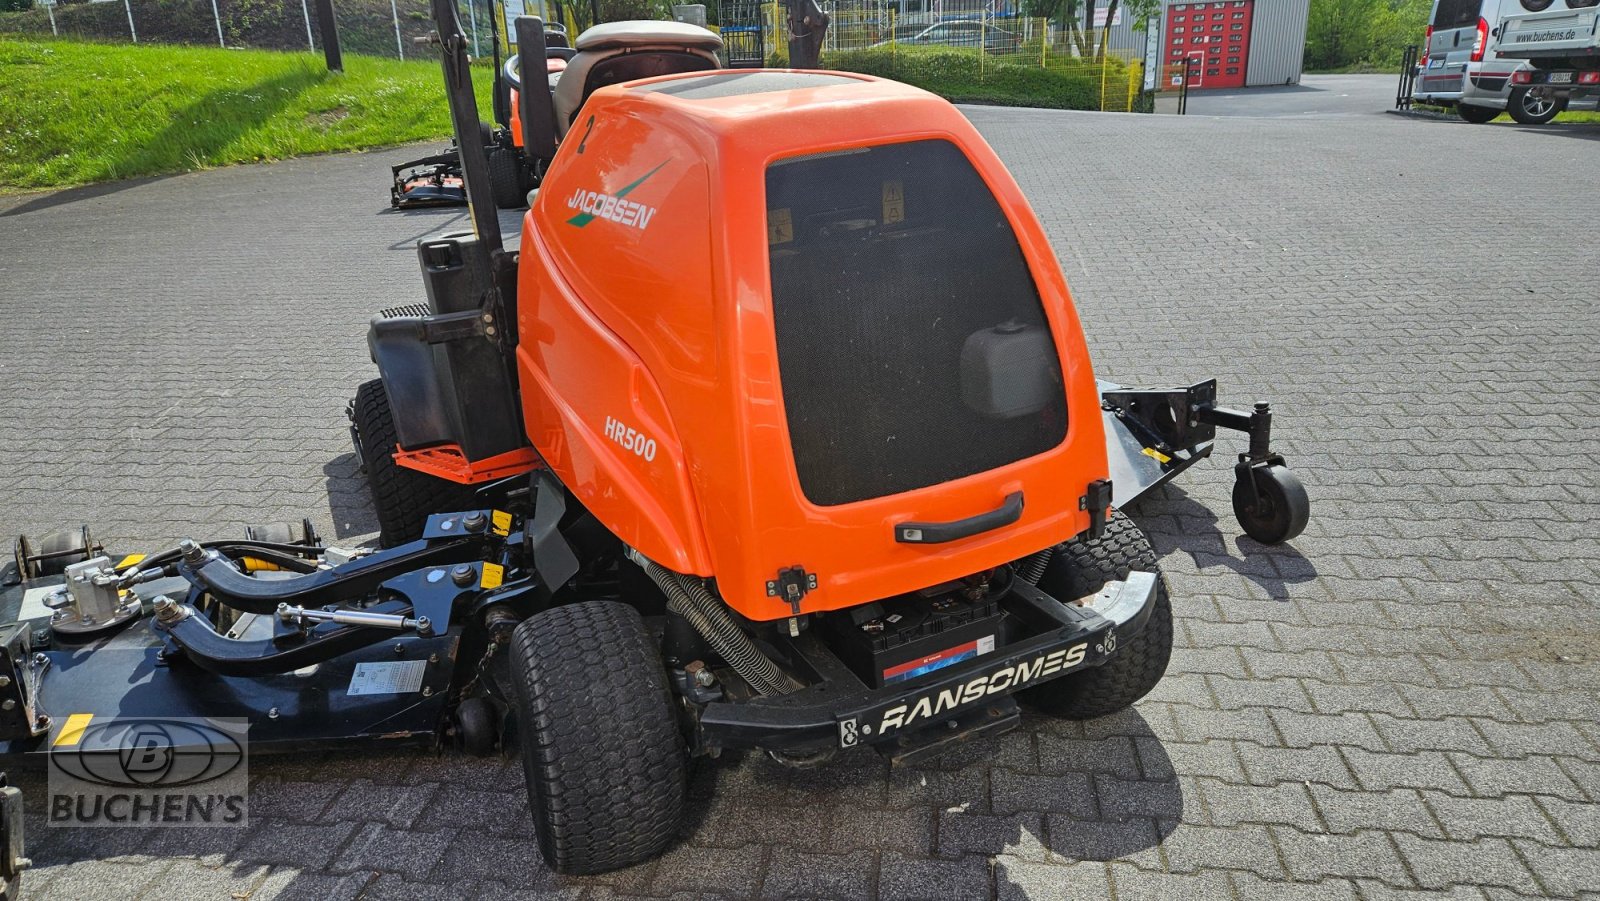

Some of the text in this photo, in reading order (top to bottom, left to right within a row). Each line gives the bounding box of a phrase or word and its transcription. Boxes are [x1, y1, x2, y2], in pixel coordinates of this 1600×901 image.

[1516, 29, 1576, 43] www.buchens.de
[577, 114, 595, 154] 2
[567, 188, 655, 230] JACOBSEN
[604, 415, 657, 462] HR500
[878, 642, 1088, 736] RANSOMES
